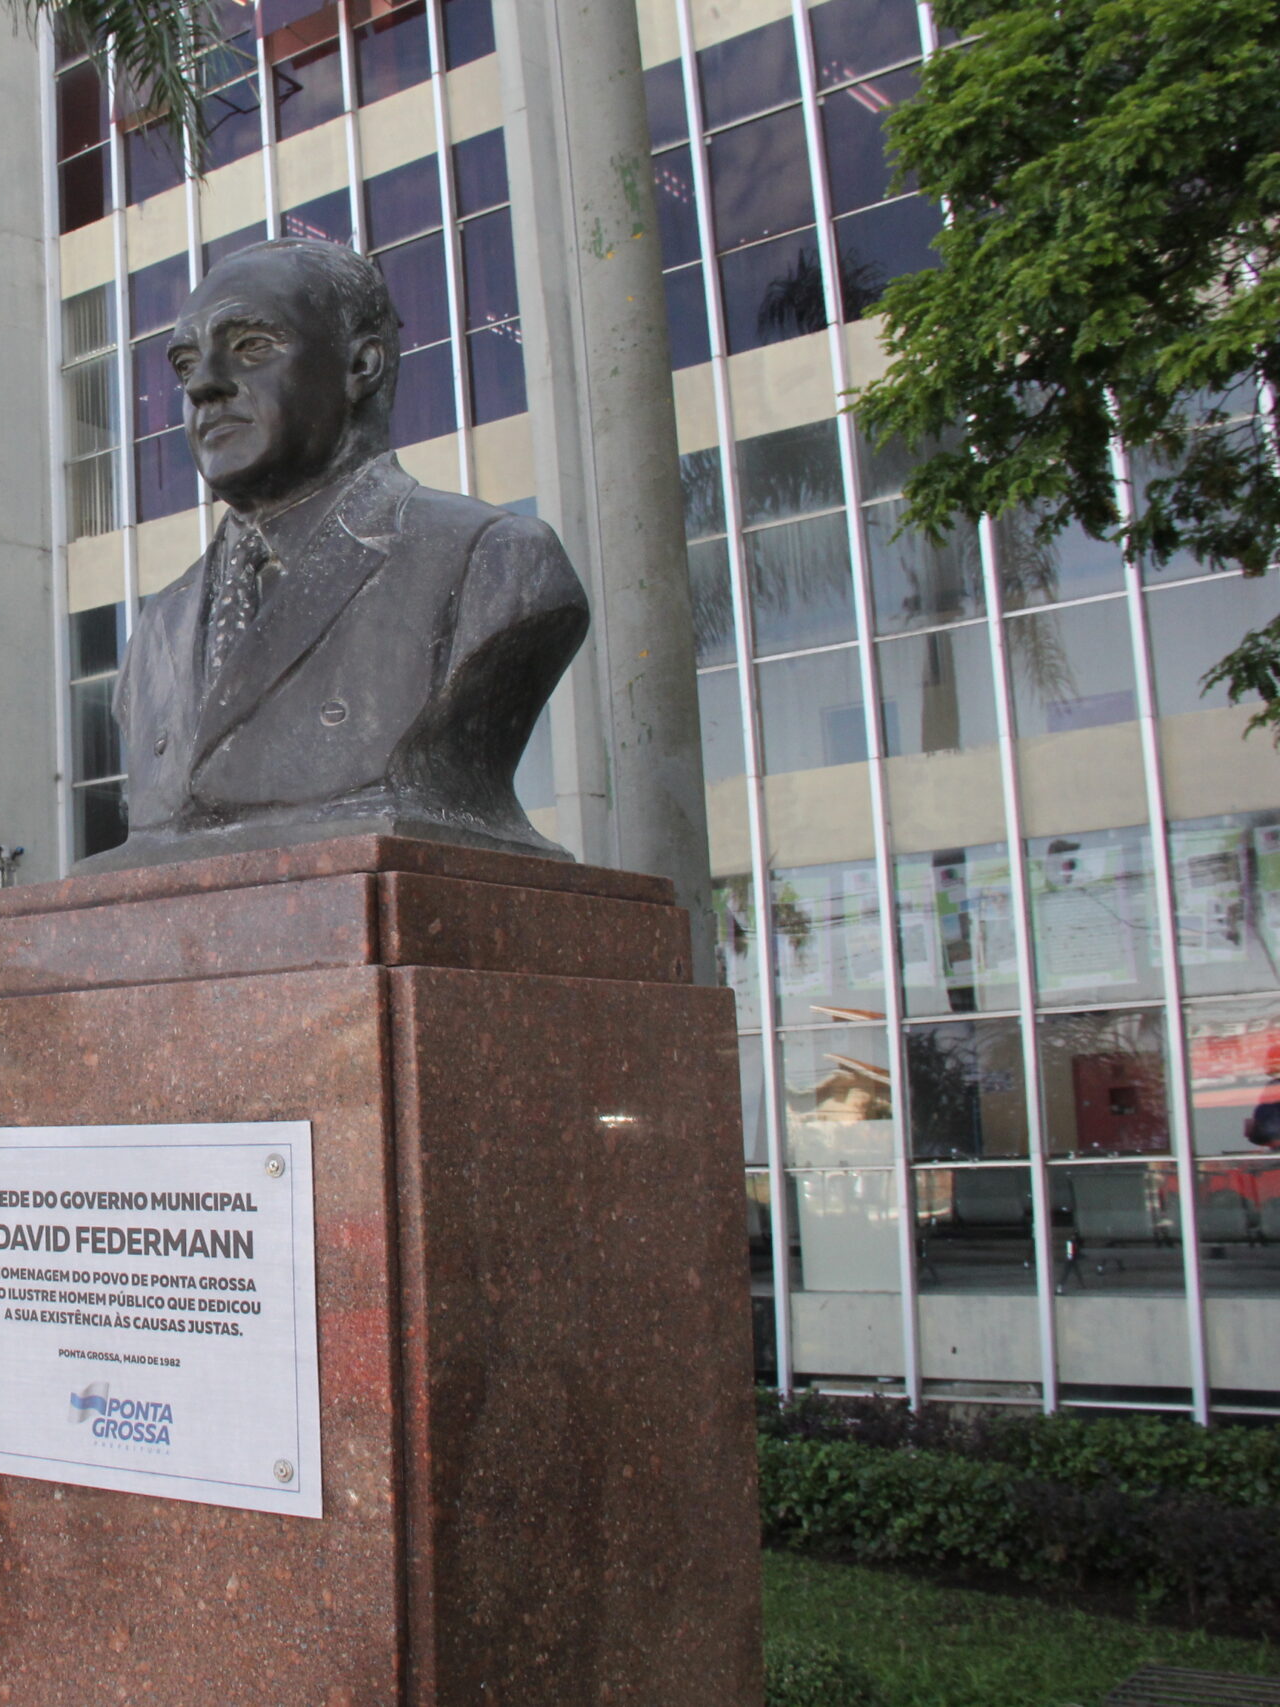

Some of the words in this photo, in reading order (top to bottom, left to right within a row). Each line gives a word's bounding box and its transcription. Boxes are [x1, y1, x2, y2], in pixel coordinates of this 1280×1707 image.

[33, 1191, 57, 1209] DO
[60, 1191, 148, 1210] GOVERNO
[151, 1192, 258, 1212] MUNICIPAL
[76, 1226, 254, 1259] FEDERMANN
[72, 1270, 91, 1284] DO
[93, 1271, 129, 1285] POVO
[131, 1273, 149, 1286] DE
[151, 1274, 197, 1289] PONTA
[199, 1276, 256, 1292] GROSSA
[8, 1287, 57, 1302] ILUSTRE
[59, 1291, 106, 1306] HOMEM
[108, 1290, 165, 1309] PÚBLICO
[167, 1297, 196, 1311] QUE
[198, 1298, 261, 1315] DEDICOU
[4, 1308, 13, 1320] A
[14, 1308, 39, 1322] SUA
[40, 1309, 112, 1328] EXISTÊNCIA
[114, 1312, 131, 1329] ÀS
[133, 1316, 186, 1333] CAUSAS
[188, 1320, 243, 1337] JUSTAS.
[58, 1348, 86, 1359] PONTA
[87, 1350, 122, 1364] GROSSA,
[123, 1354, 146, 1365] MAIO
[147, 1356, 159, 1365] DE
[160, 1357, 181, 1367] 1982
[107, 1398, 173, 1424] PONTA
[92, 1417, 170, 1445] GROSSA
